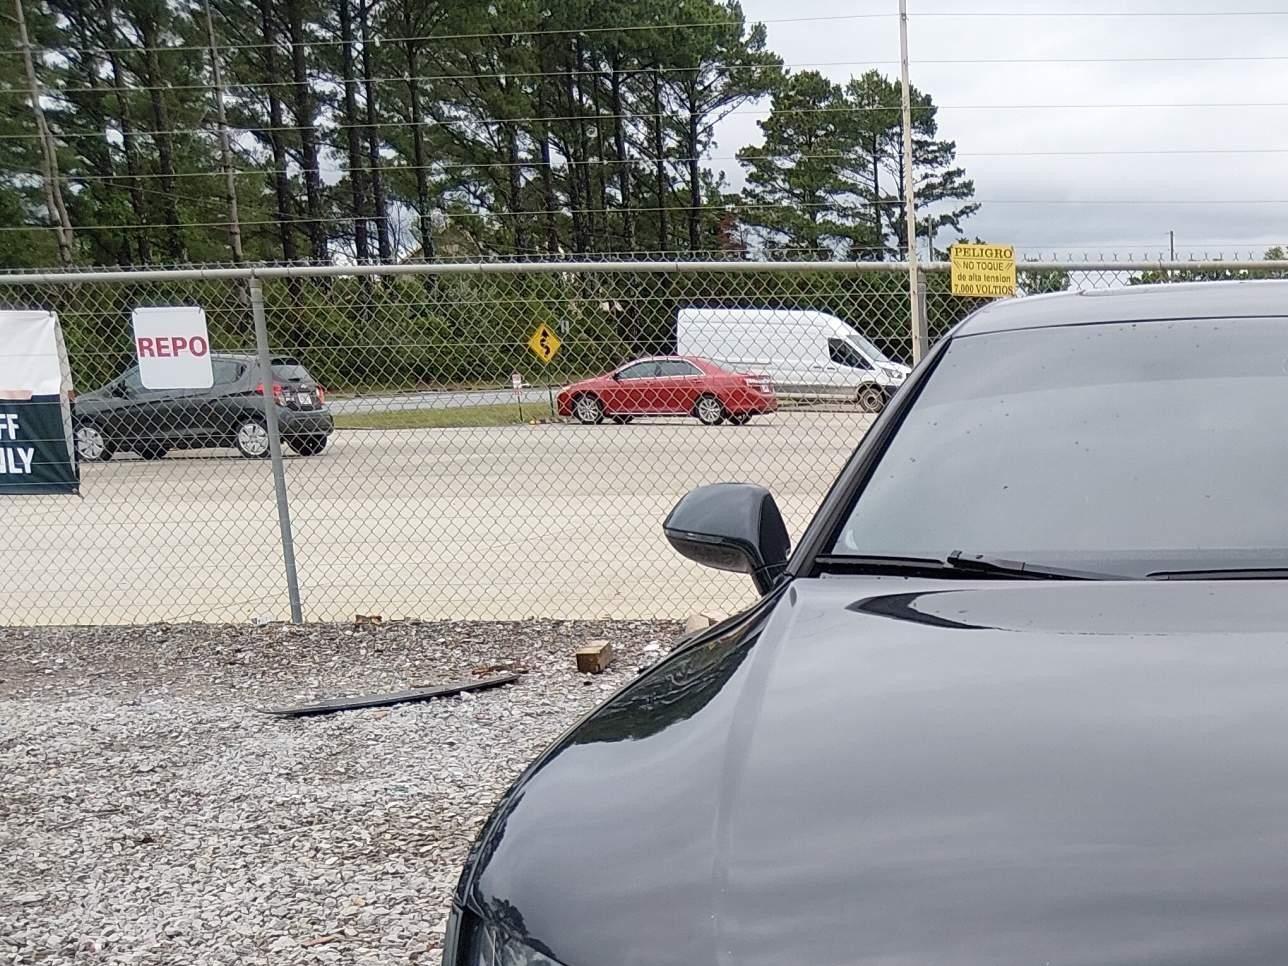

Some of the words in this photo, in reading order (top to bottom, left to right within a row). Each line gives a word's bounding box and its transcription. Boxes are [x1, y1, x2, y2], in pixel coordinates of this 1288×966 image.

[954, 247, 1013, 259] PELIGRO
[962, 261, 975, 270] NO
[976, 261, 1004, 271] TOQUE
[969, 273, 982, 282] alta
[975, 284, 1014, 295] VOLTIOS
[137, 336, 208, 358] REPO
